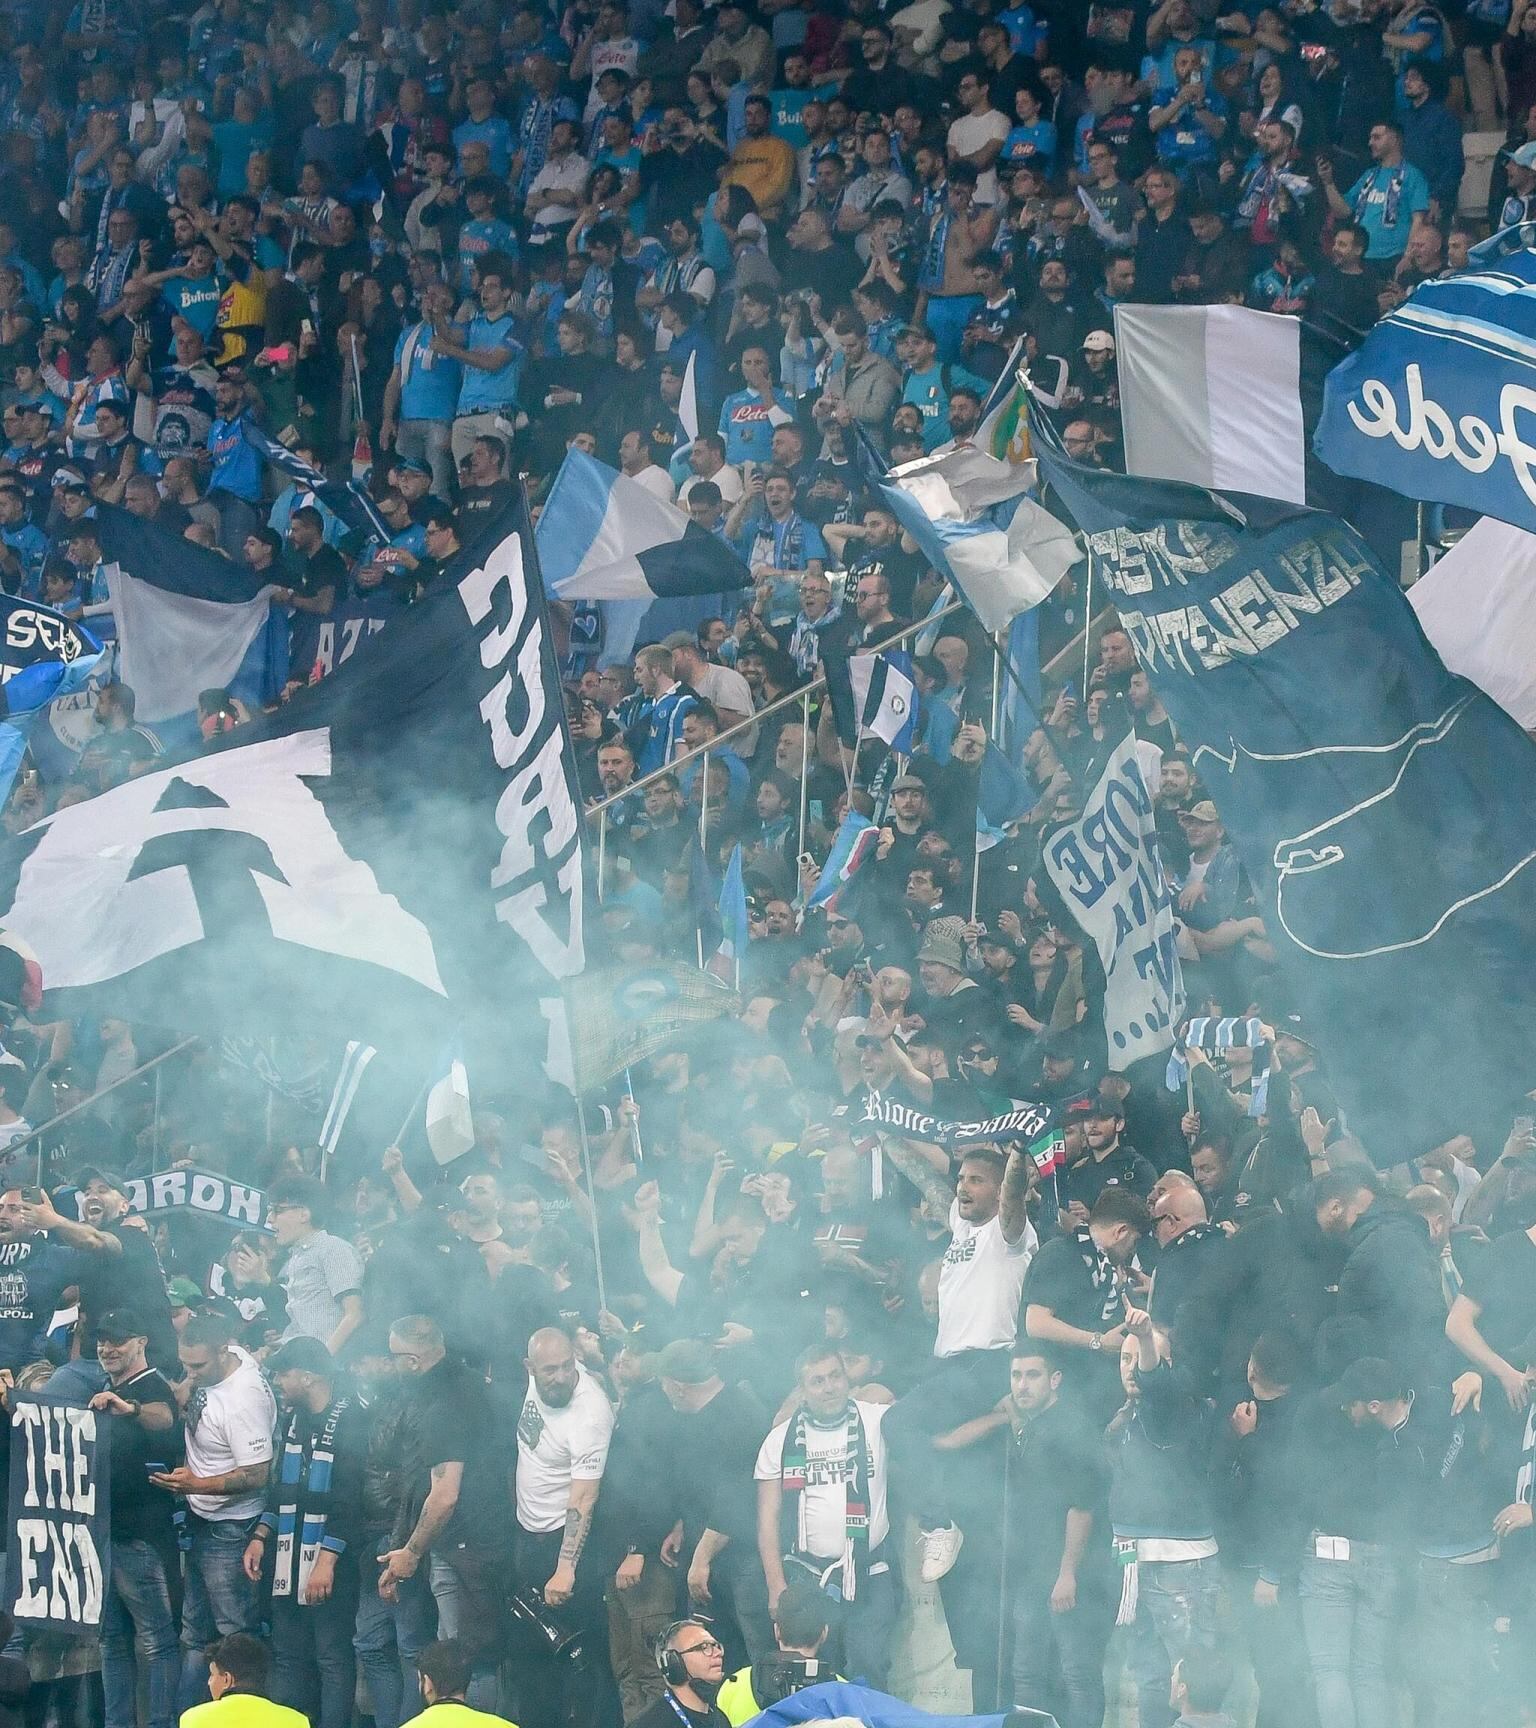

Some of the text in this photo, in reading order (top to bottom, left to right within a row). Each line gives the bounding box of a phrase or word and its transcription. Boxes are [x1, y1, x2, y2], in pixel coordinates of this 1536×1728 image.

[860, 1089, 935, 1133] Rione
[12, 1402, 97, 1516] THE
[13, 1518, 103, 1624] END
